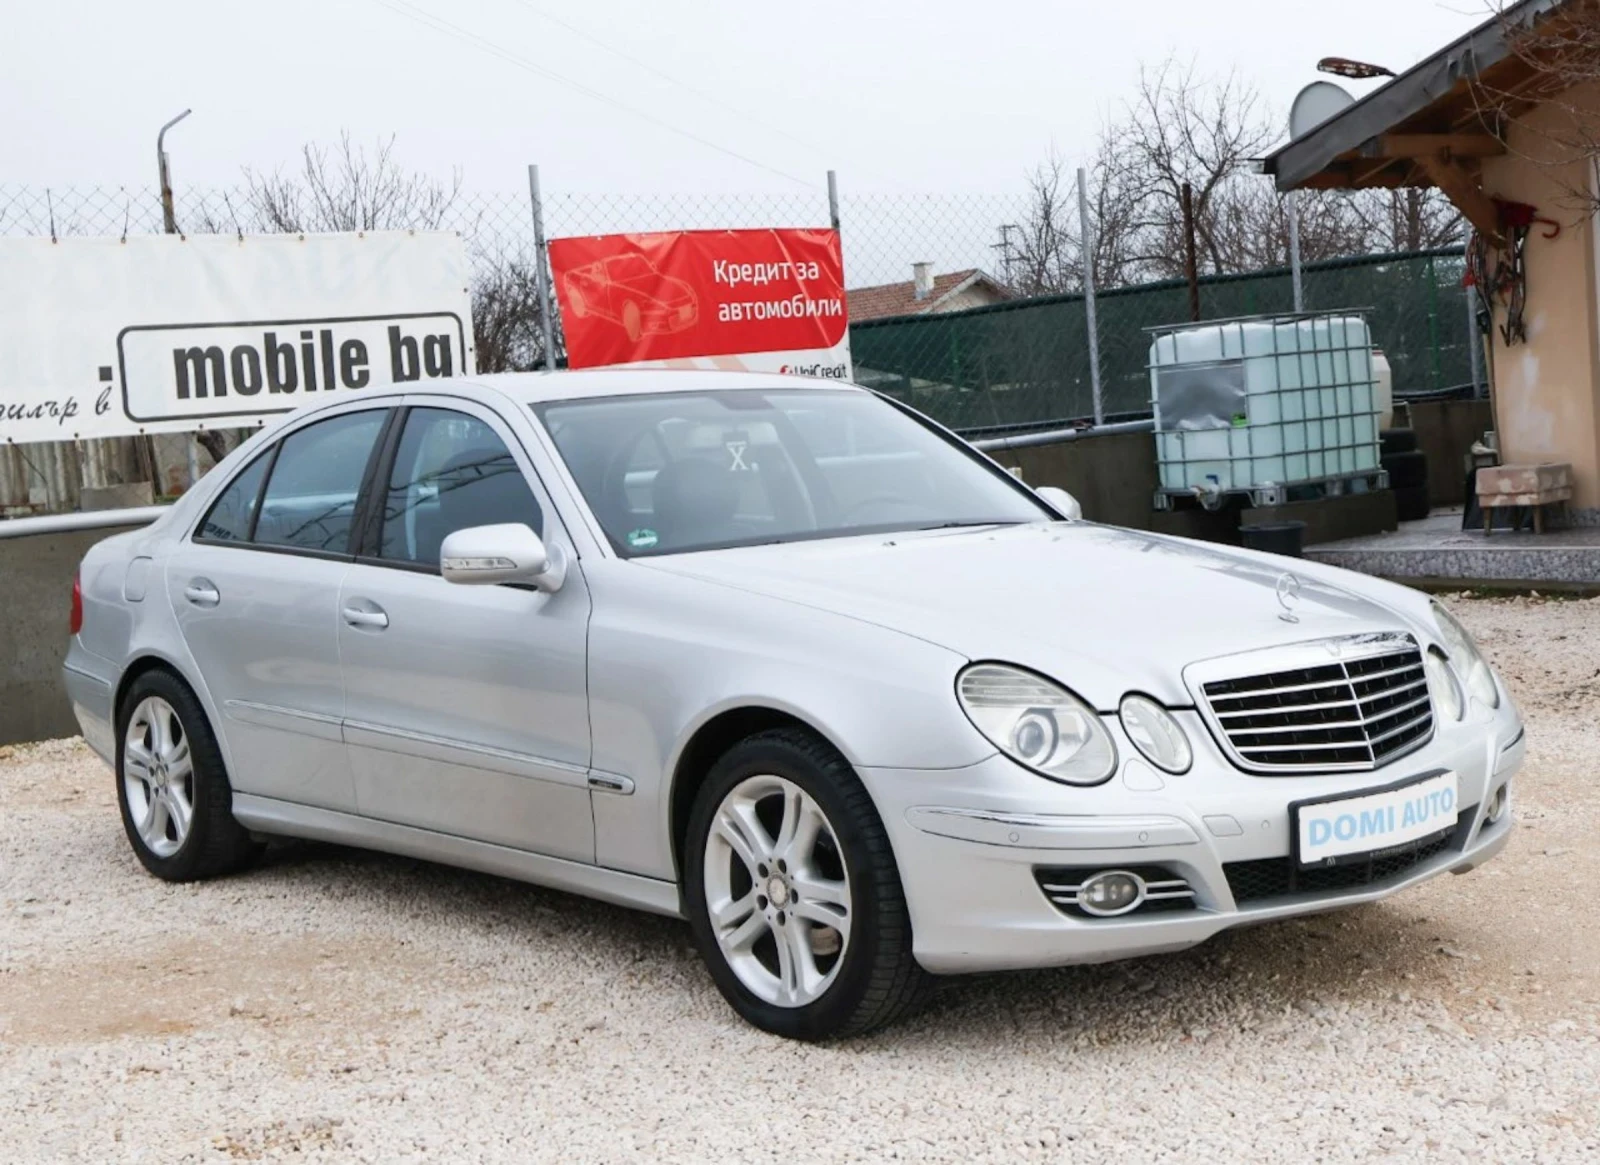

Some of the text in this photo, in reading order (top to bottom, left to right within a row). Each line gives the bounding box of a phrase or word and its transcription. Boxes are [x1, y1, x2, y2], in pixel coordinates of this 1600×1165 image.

[713, 260, 819, 288] Кредит за
[718, 294, 842, 322] автомобили
[173, 329, 370, 400] mobile
[1309, 787, 1454, 847] DOMI AUTO
